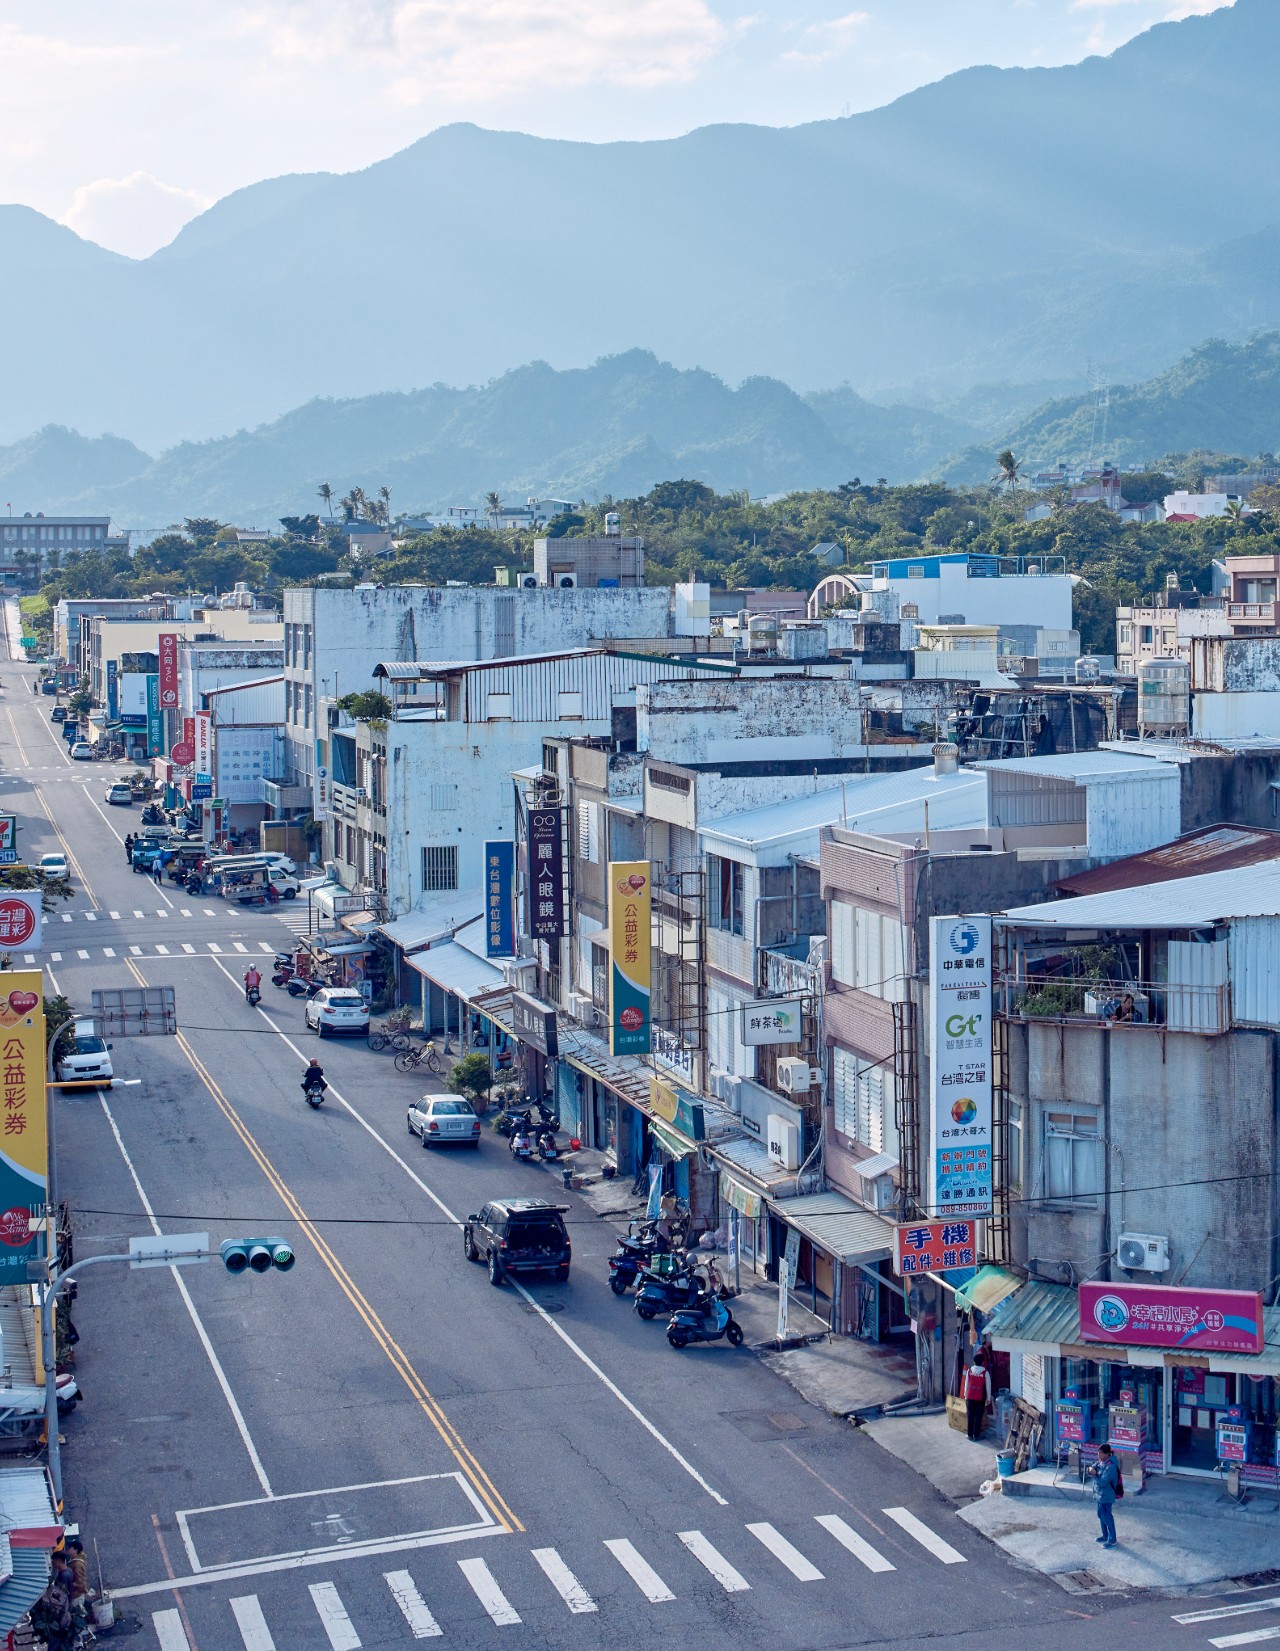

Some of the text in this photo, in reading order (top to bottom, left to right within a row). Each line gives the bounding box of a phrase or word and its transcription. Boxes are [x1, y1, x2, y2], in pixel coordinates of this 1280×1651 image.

[537, 843, 555, 917] 麗人眼鏡
[624, 903, 638, 963] 公益彩券
[943, 957, 985, 971] 中華電信
[750, 1016, 783, 1030] 鮮茶道
[945, 1037, 983, 1050] 智慧生活
[965, 1062, 986, 1070] STAR
[3, 1038, 27, 1136] 公益彩券
[941, 1187, 988, 1200] 達勝通訊
[941, 1202, 988, 1214] 089-850860
[905, 1223, 970, 1250] 手機
[1132, 1304, 1198, 1325] 幸福水屋
[1132, 1321, 1149, 1330] 24H
